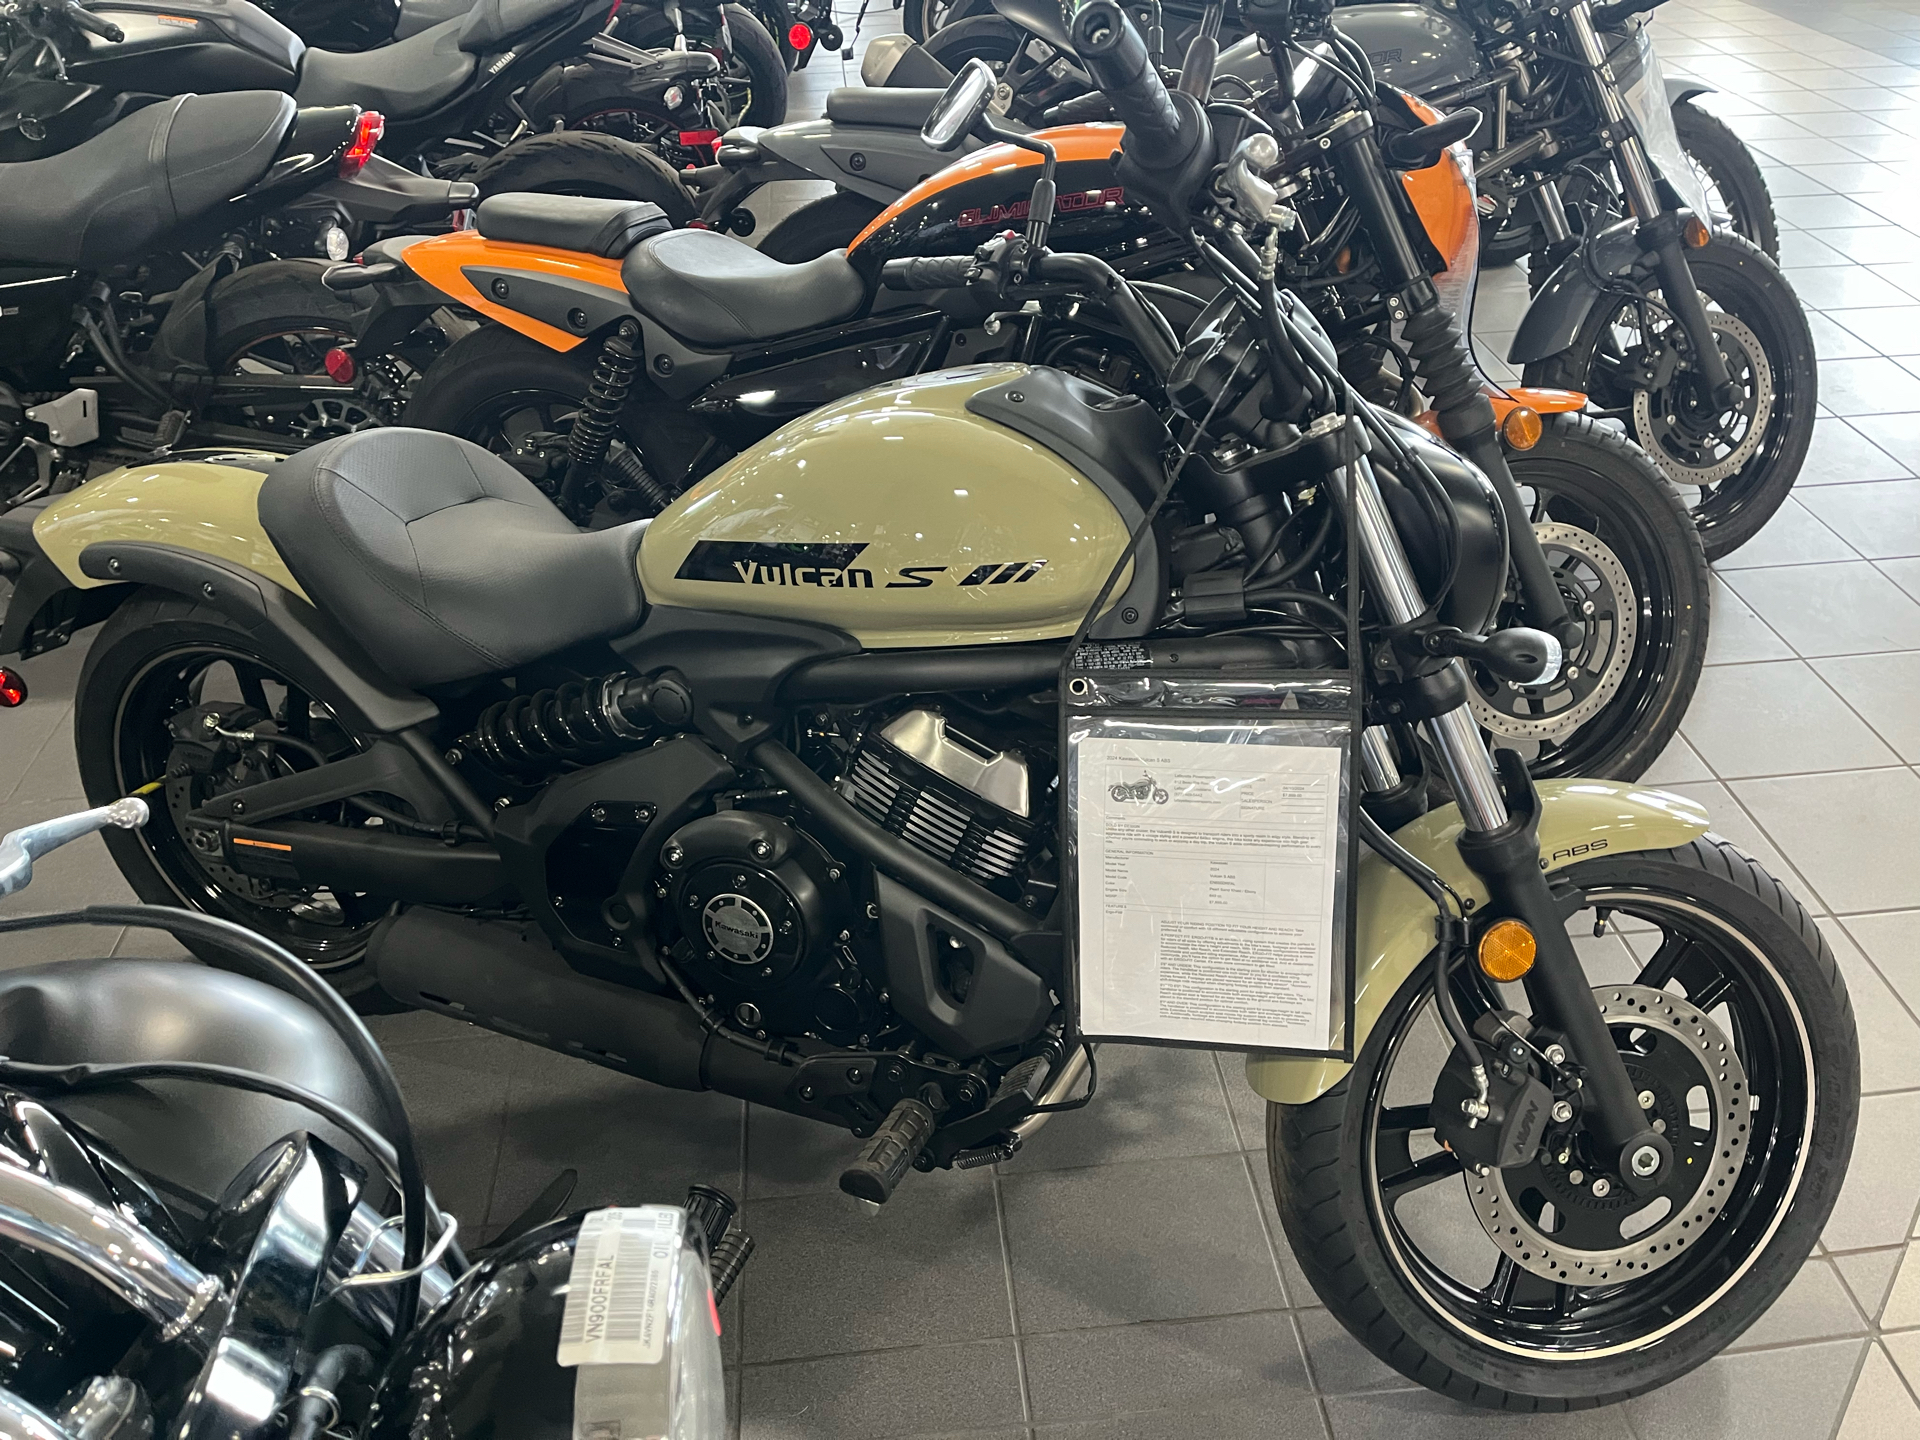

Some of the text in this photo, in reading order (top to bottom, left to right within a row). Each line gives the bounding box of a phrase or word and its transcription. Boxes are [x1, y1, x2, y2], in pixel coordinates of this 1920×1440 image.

[488, 51, 516, 75] YAMAHA
[957, 186, 1125, 228] ELIMITOR
[733, 559, 948, 589] Vulcan S
[1552, 839, 1608, 862] ABS
[715, 920, 759, 939] Kawasaki
[584, 1254, 615, 1344] VN900FRFAL
